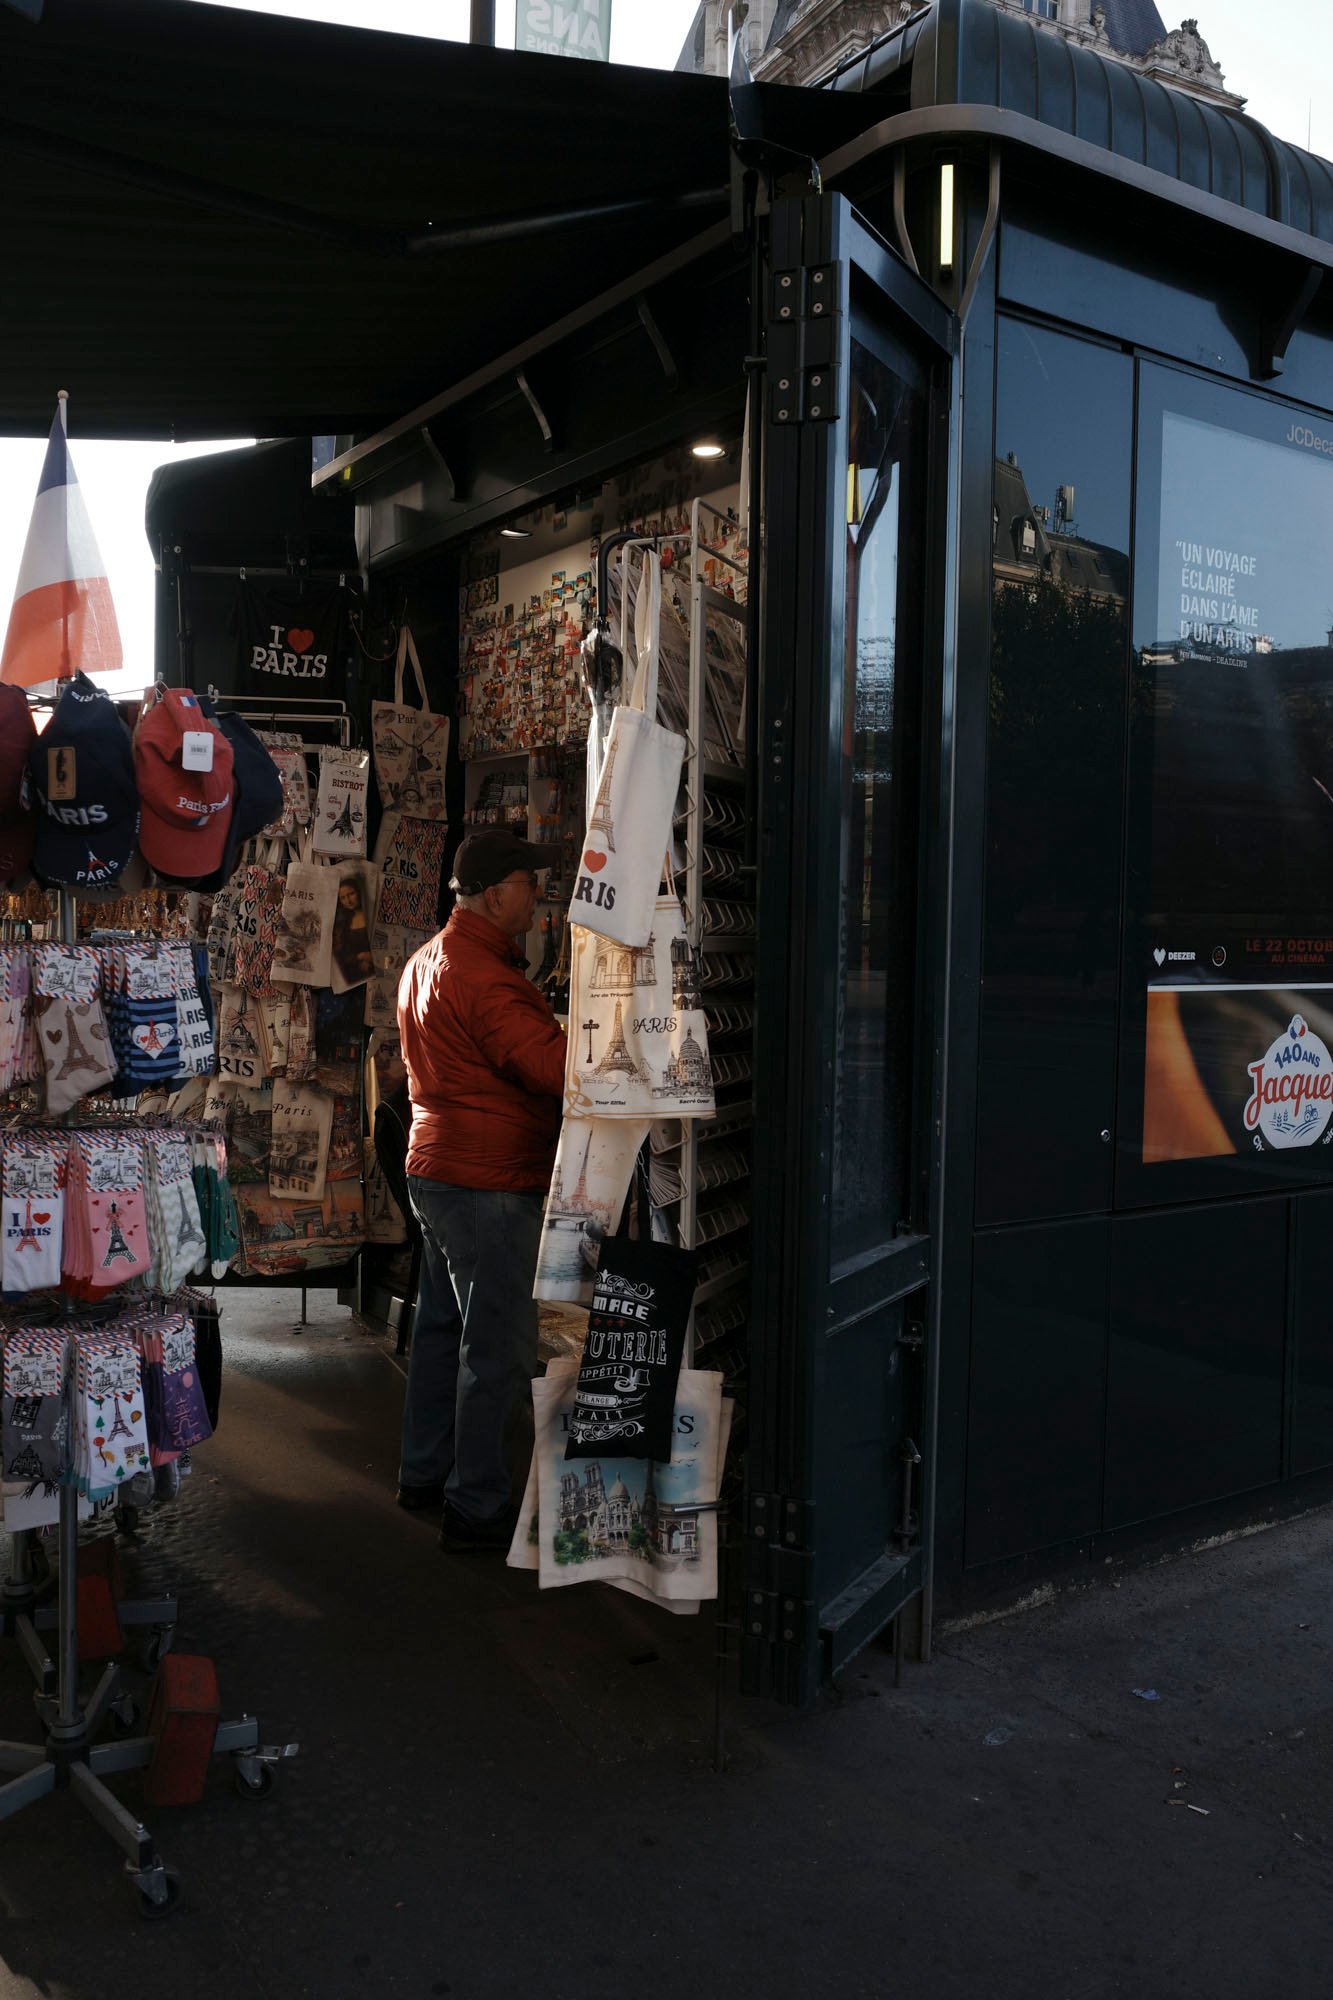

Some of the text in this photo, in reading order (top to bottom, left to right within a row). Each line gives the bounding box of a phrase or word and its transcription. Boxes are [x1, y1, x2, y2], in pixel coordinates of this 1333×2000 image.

[1206, 547, 1257, 577] VOYAGE
[1181, 562, 1236, 597] ÉCLAIRÉ
[1181, 594, 1259, 627] DANS L'ÂME
[268, 625, 285, 649] I
[1180, 620, 1213, 644] D'UN
[250, 646, 328, 678] PARIS
[332, 778, 365, 792] BISTROT
[36, 787, 109, 826] ARIS
[176, 796, 208, 814] Paris
[76, 860, 118, 881] PARIS
[574, 876, 616, 911] RIS
[236, 909, 257, 936] RIS
[1168, 951, 1196, 961] DEEZER
[1245, 938, 1262, 953] LE
[1265, 938, 1282, 953] 22
[180, 986, 200, 1001] RIS
[216, 1056, 254, 1077] RIS
[1275, 1043, 1321, 1069] 140 ANS
[272, 1103, 313, 1117] Paris
[12, 1213, 20, 1227] I
[7, 1227, 51, 1238] PARIS
[592, 1295, 650, 1321] MAGE
[589, 1328, 668, 1366] UTERIE
[576, 1409, 625, 1421] FAIT
